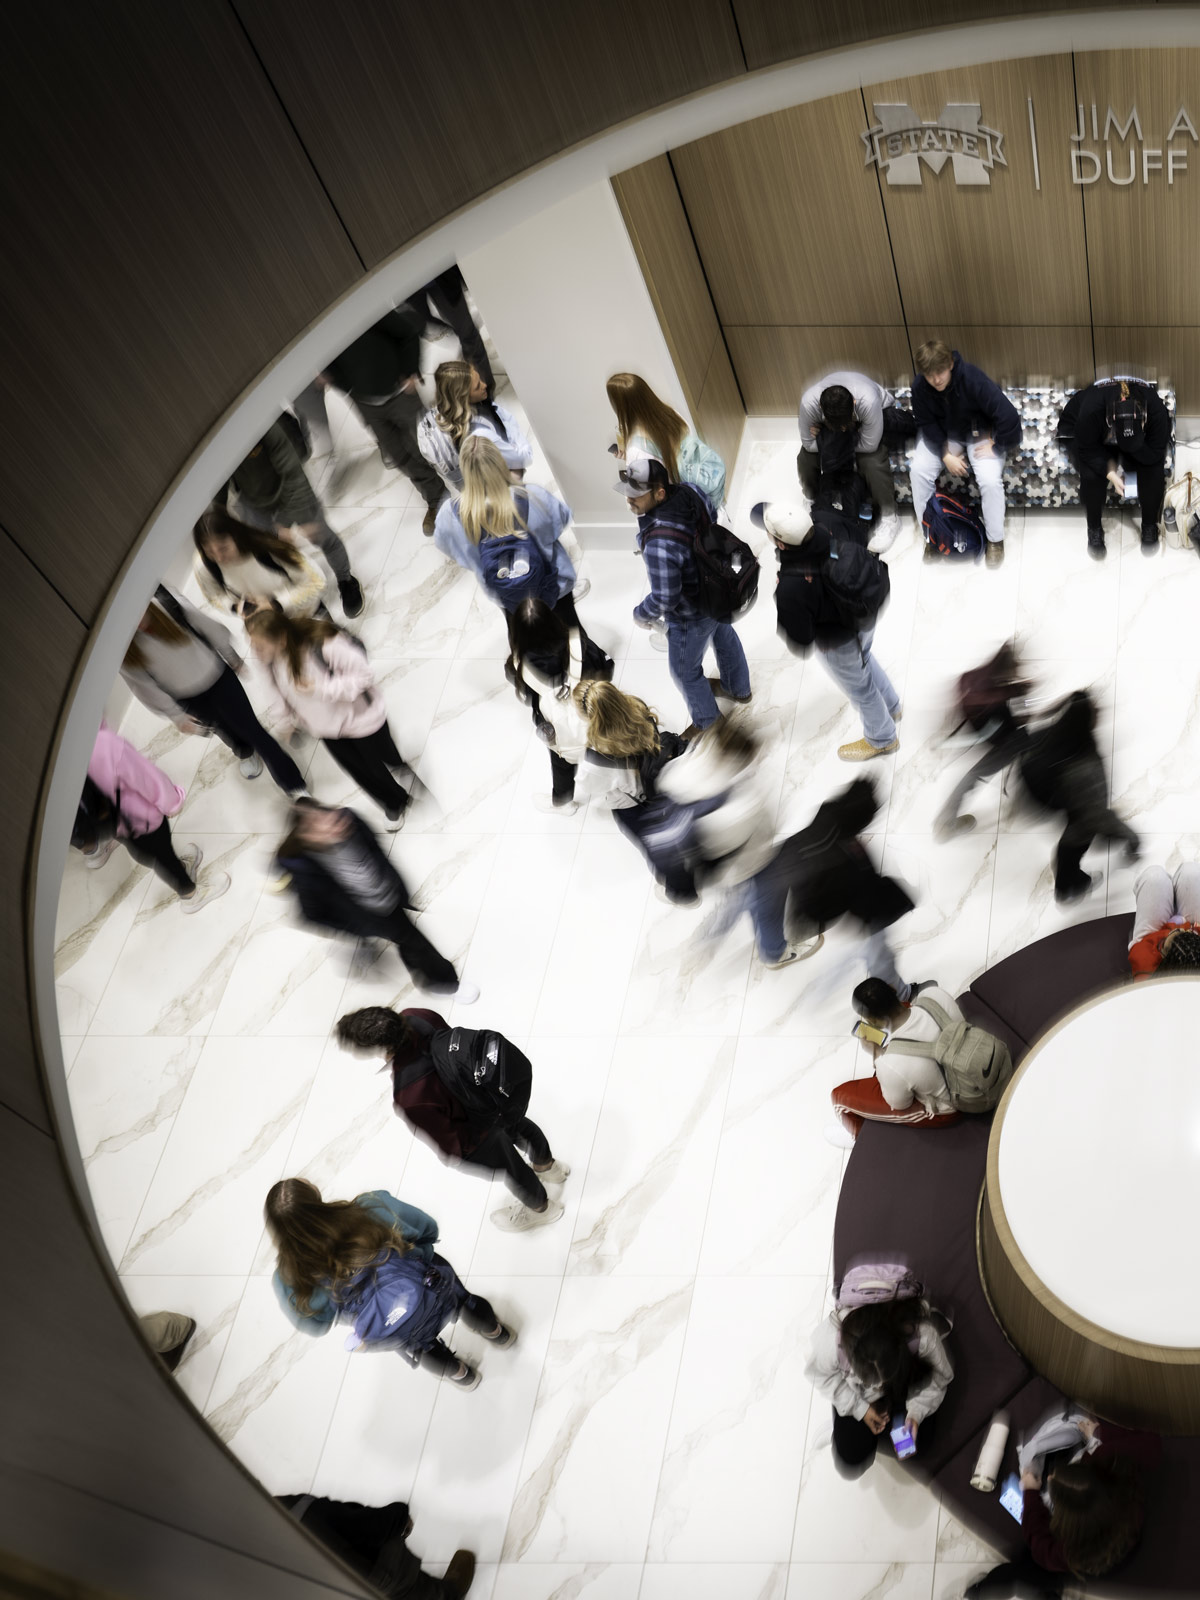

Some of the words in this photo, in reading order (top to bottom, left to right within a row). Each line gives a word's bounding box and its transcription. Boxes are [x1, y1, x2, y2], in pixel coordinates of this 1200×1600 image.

[1070, 104, 1143, 141] JIM
[886, 129, 980, 157] STATE
[1071, 149, 1188, 185] DUFF
